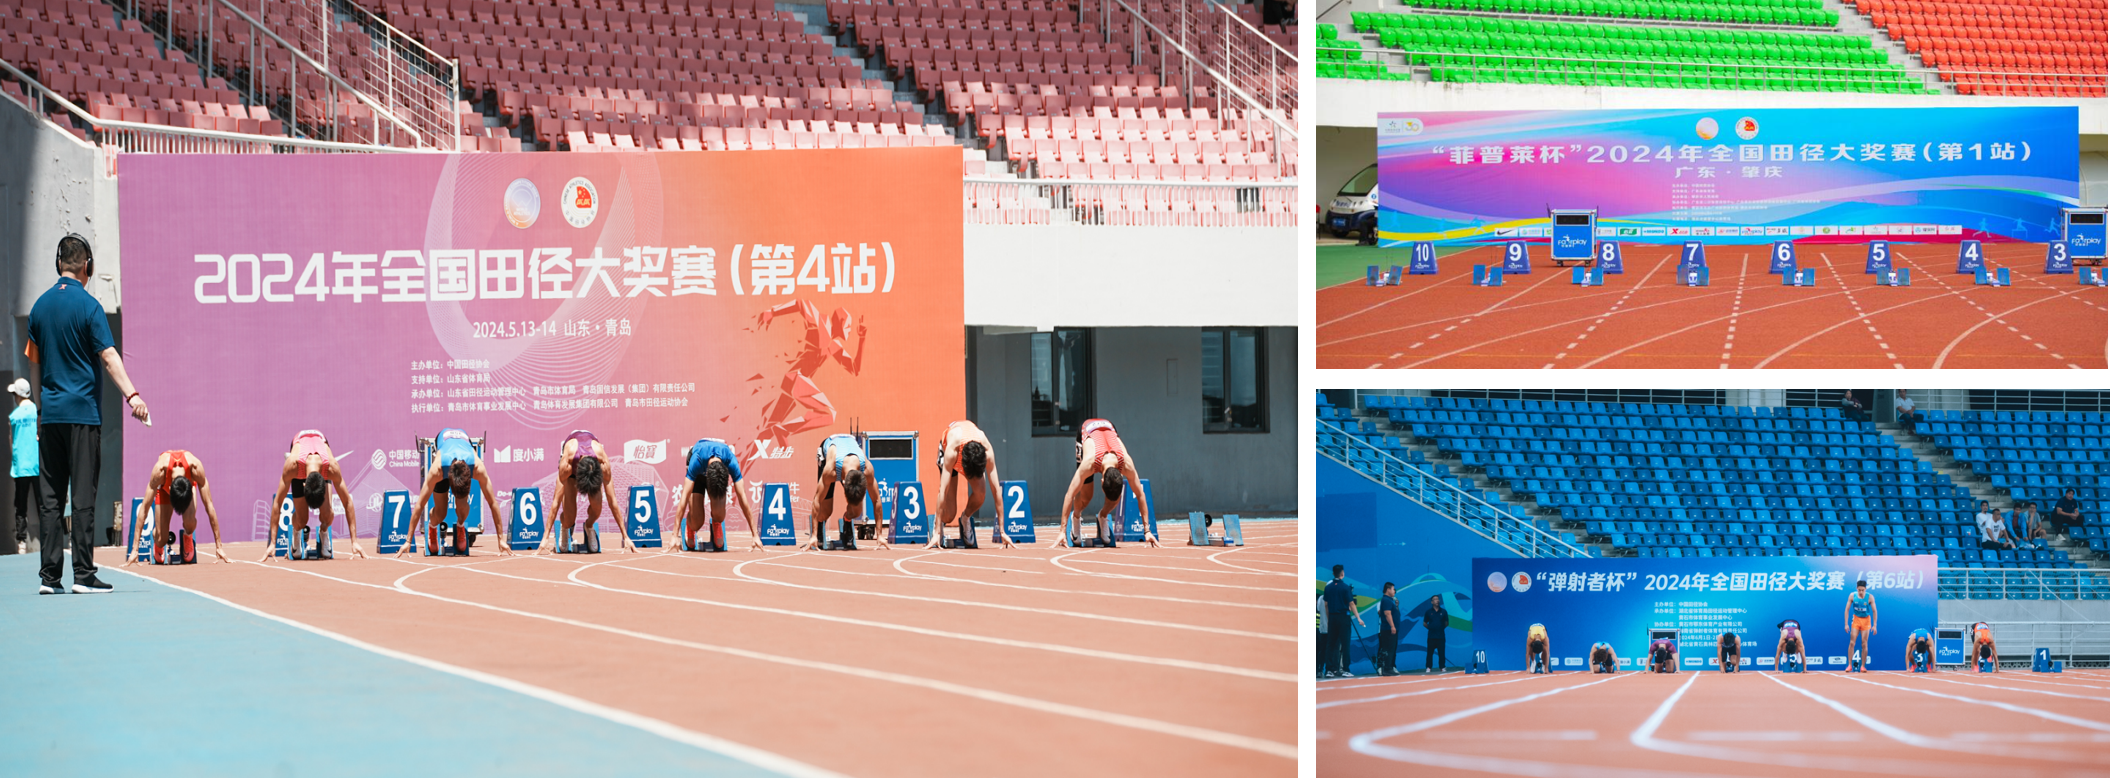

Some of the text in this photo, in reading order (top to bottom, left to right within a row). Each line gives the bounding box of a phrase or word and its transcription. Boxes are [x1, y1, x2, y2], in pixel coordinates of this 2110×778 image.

[1416, 243, 1430, 262] 10
[1508, 243, 1522, 262] 9
[1602, 243, 1616, 262] 8
[1686, 243, 1699, 262] 7
[1777, 243, 1791, 262] 6
[1872, 243, 1886, 261] 5
[1964, 242, 1979, 261] 4
[2053, 243, 2067, 262] 3
[194, 242, 896, 304] 2024年全国田径大奖赛（第4站）
[473, 318, 632, 338] 2024.5.13-14 山东·青岛
[533, 385, 576, 396] 青岛市体育局
[389, 450, 420, 460] 中国移动
[389, 460, 402, 468] China
[513, 448, 545, 462] 度小满
[519, 492, 537, 526] 6
[634, 490, 652, 523] 5
[768, 488, 786, 521] 4
[903, 486, 920, 520] 3
[1007, 485, 1025, 519] 2
[136, 502, 155, 536] 9
[278, 497, 294, 532] 8
[388, 495, 406, 529] 7
[1536, 571, 1638, 592] “弹射者杯”
[1475, 650, 1486, 663] 10
[1852, 649, 1862, 662] 4
[2039, 650, 2047, 661] 1
